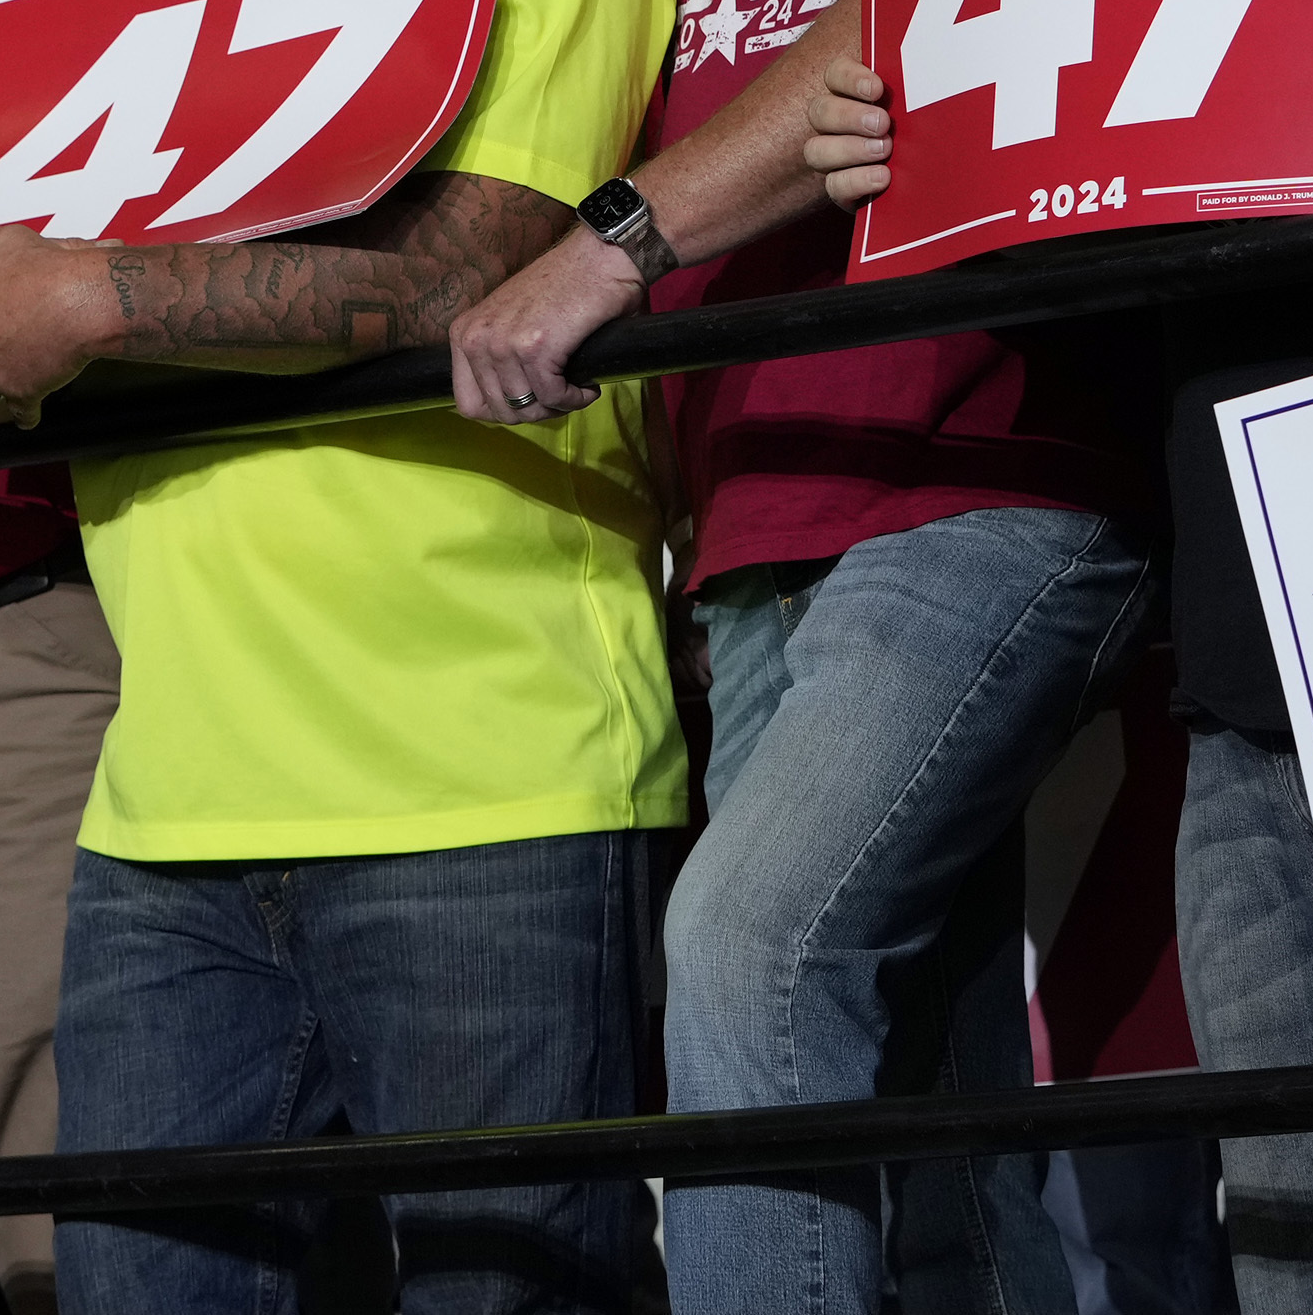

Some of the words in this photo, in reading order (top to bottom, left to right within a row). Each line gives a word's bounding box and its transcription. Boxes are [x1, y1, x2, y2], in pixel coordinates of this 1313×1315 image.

[1028, 176, 1127, 223] 2024
[1201, 197, 1221, 206] PAID
[1221, 196, 1238, 204] FOR
[1238, 195, 1249, 203] BY
[1249, 193, 1283, 203] DONALD
[1283, 192, 1291, 201] J.
[107, 254, 146, 321] Love
